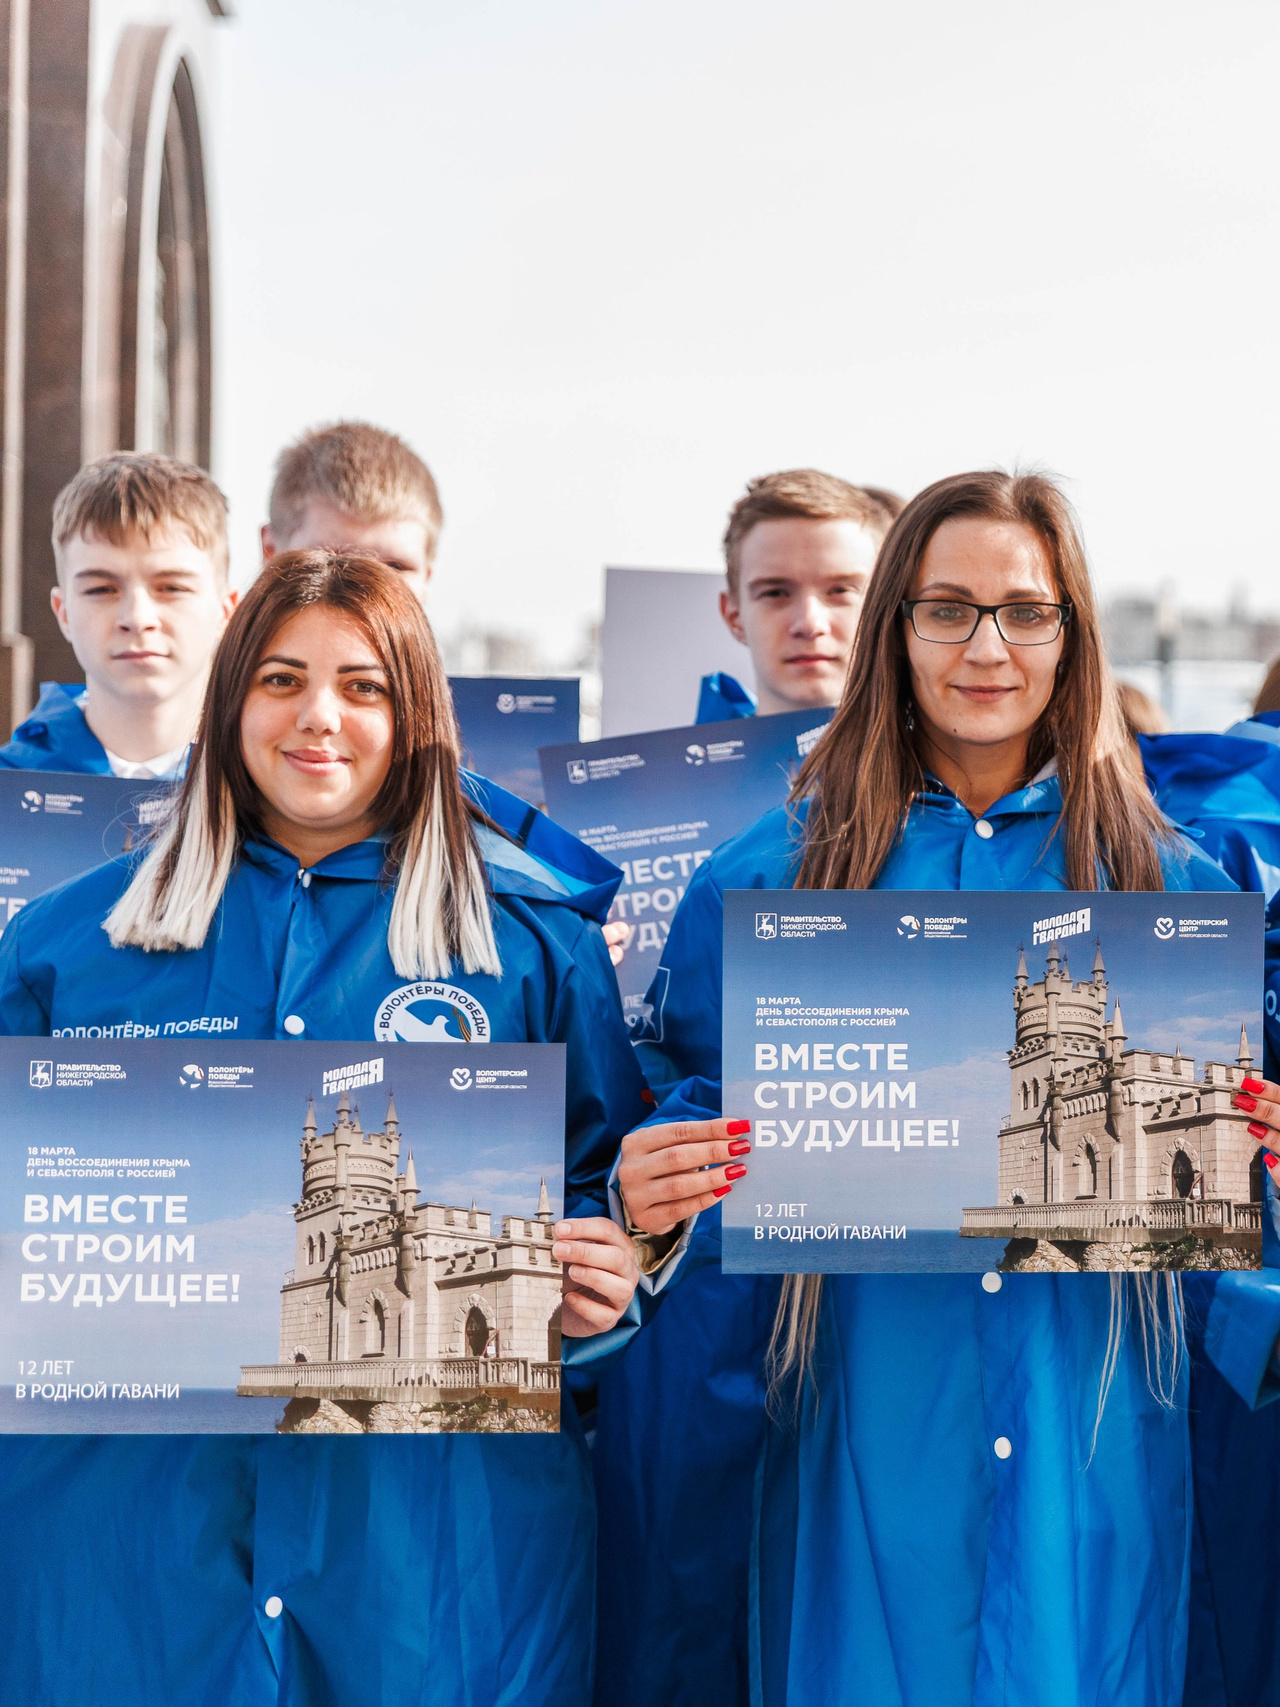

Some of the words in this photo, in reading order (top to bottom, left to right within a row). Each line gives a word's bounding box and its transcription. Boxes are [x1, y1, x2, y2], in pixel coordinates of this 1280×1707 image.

[781, 922, 847, 931] НИЖЕГОРОДСКОЙ
[1033, 908, 1091, 933] МОЛОДАЯ
[380, 984, 445, 1029] ВОЛОНТЁРЫ
[448, 990, 486, 1036] ПОБЕДЫ
[756, 997, 766, 1005] 18
[768, 997, 801, 1005] МАРТА
[756, 1008, 782, 1017] ДЕНЬ
[785, 1008, 871, 1017] ВОССОЕДИНЕНИЯ
[756, 1018, 763, 1026] И
[766, 1018, 838, 1026] СЕВАСТОПОЛЯ
[840, 1018, 847, 1026] С
[850, 1017, 896, 1026] РОССИЕЙ
[52, 1020, 160, 1038] ВОЛОНТЁРЫ
[164, 1016, 238, 1035] ПОБЕДЫ
[755, 1043, 908, 1071] ВМЕСТЕ
[56, 1071, 126, 1080] НИЖЕГОРОДСКОЙ
[208, 1066, 254, 1074] ВОЛОНТЁРЫ
[323, 1058, 384, 1083] МОЛОДАЯ
[754, 1081, 916, 1109] СТРОИМ
[755, 1120, 959, 1152] БУДУЩЕЕ!
[28, 1147, 38, 1155] 18
[41, 1147, 76, 1155] МАРТА
[27, 1158, 55, 1167] ДЕНЬ
[58, 1158, 150, 1167] ВОССОЕДИНЕНИЯ
[153, 1159, 190, 1167] КРЫМА
[27, 1169, 34, 1177] И
[37, 1169, 114, 1177] СЕВАСТОПОЛЯ
[117, 1169, 124, 1178] С
[127, 1168, 176, 1178] РОССИЕЙ
[24, 1194, 188, 1223] ВМЕСТЕ
[756, 1204, 773, 1217] 12
[777, 1203, 808, 1217] ЛЕТ
[754, 1225, 764, 1240] В
[769, 1223, 840, 1243] РОДНОЙ
[844, 1226, 907, 1240] ГАВАНИ
[22, 1234, 195, 1263] СТРОИМ
[20, 1273, 240, 1307] БУДУЩЕЕ!
[19, 1360, 37, 1375] 12
[41, 1360, 74, 1375] ЛЕТ
[16, 1383, 26, 1399] В
[30, 1381, 107, 1401] РОДНОЙ
[111, 1384, 180, 1399] ГАВАНИ
